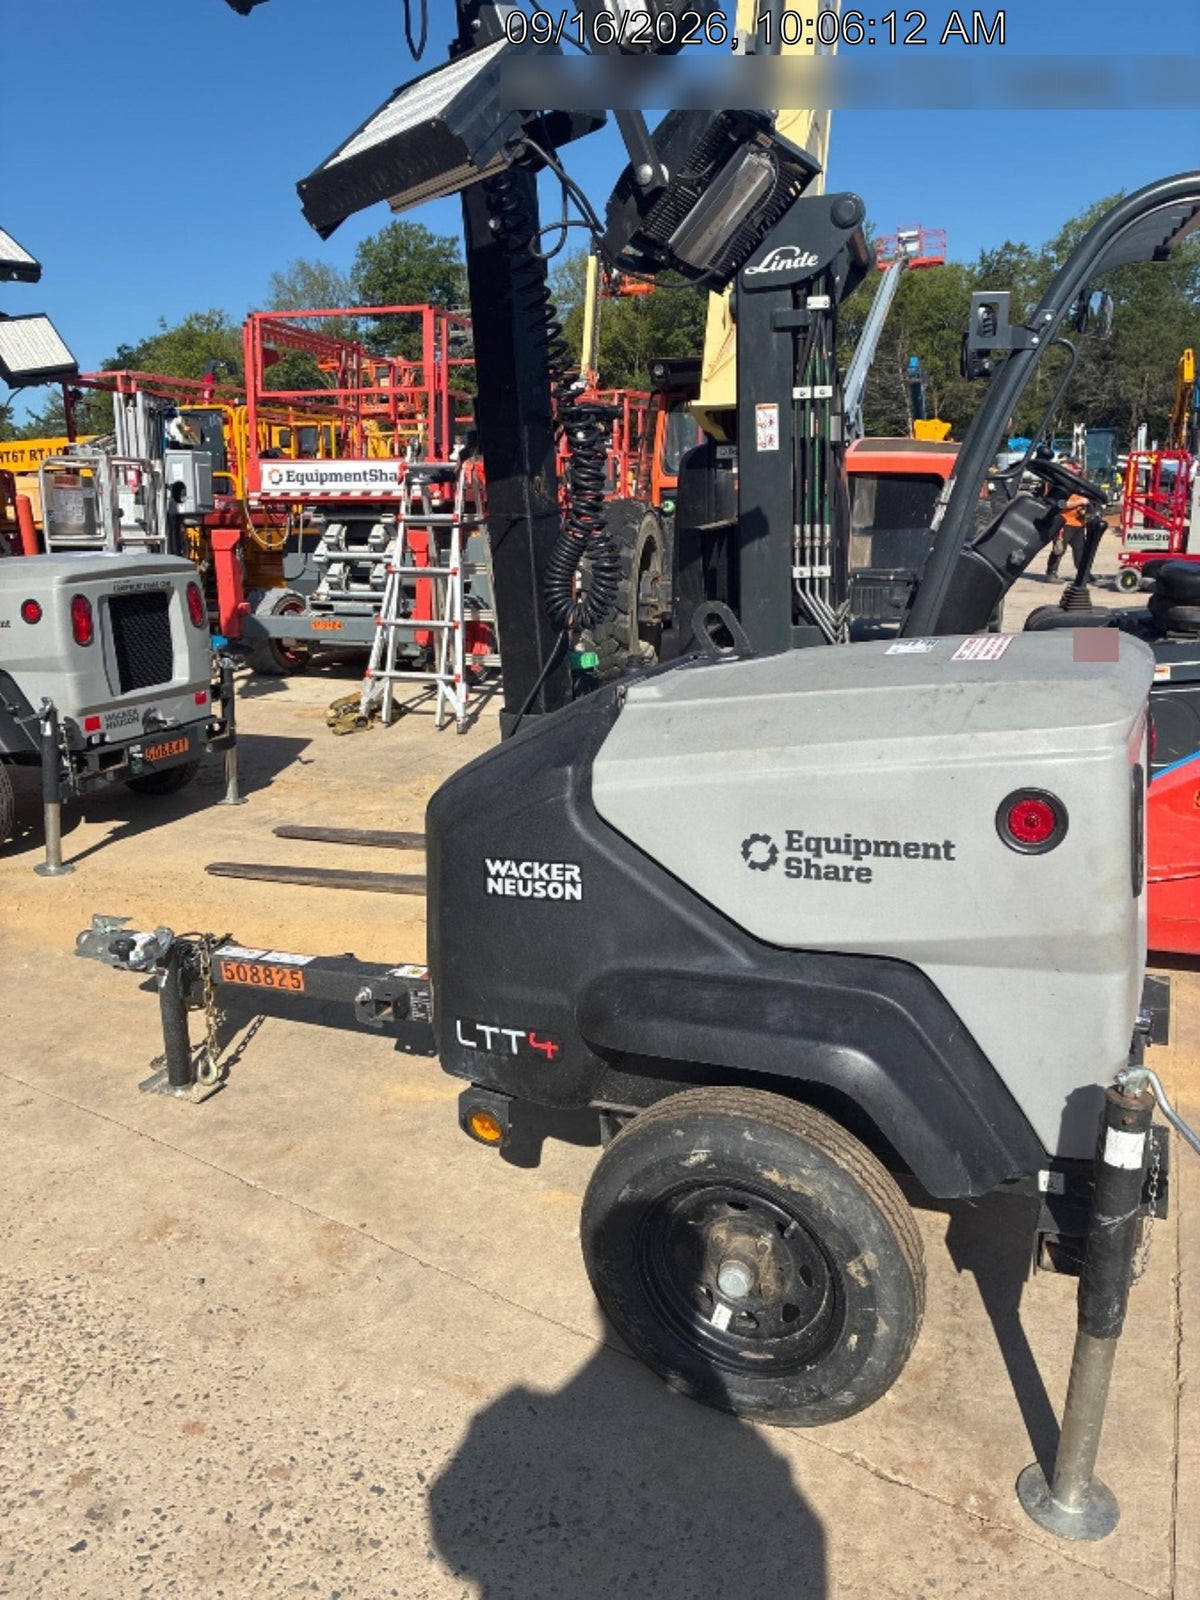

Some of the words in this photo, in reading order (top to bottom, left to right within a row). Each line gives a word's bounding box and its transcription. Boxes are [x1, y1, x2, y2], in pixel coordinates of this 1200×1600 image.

[744, 245, 819, 275] Linde
[285, 468, 398, 486] EquipmentSha
[784, 829, 956, 862] Equipment
[484, 858, 582, 882] WACKER
[784, 856, 873, 884] Share
[486, 877, 582, 900] NEUSON
[222, 962, 302, 990] 508825
[456, 1019, 559, 1060] LTT4
